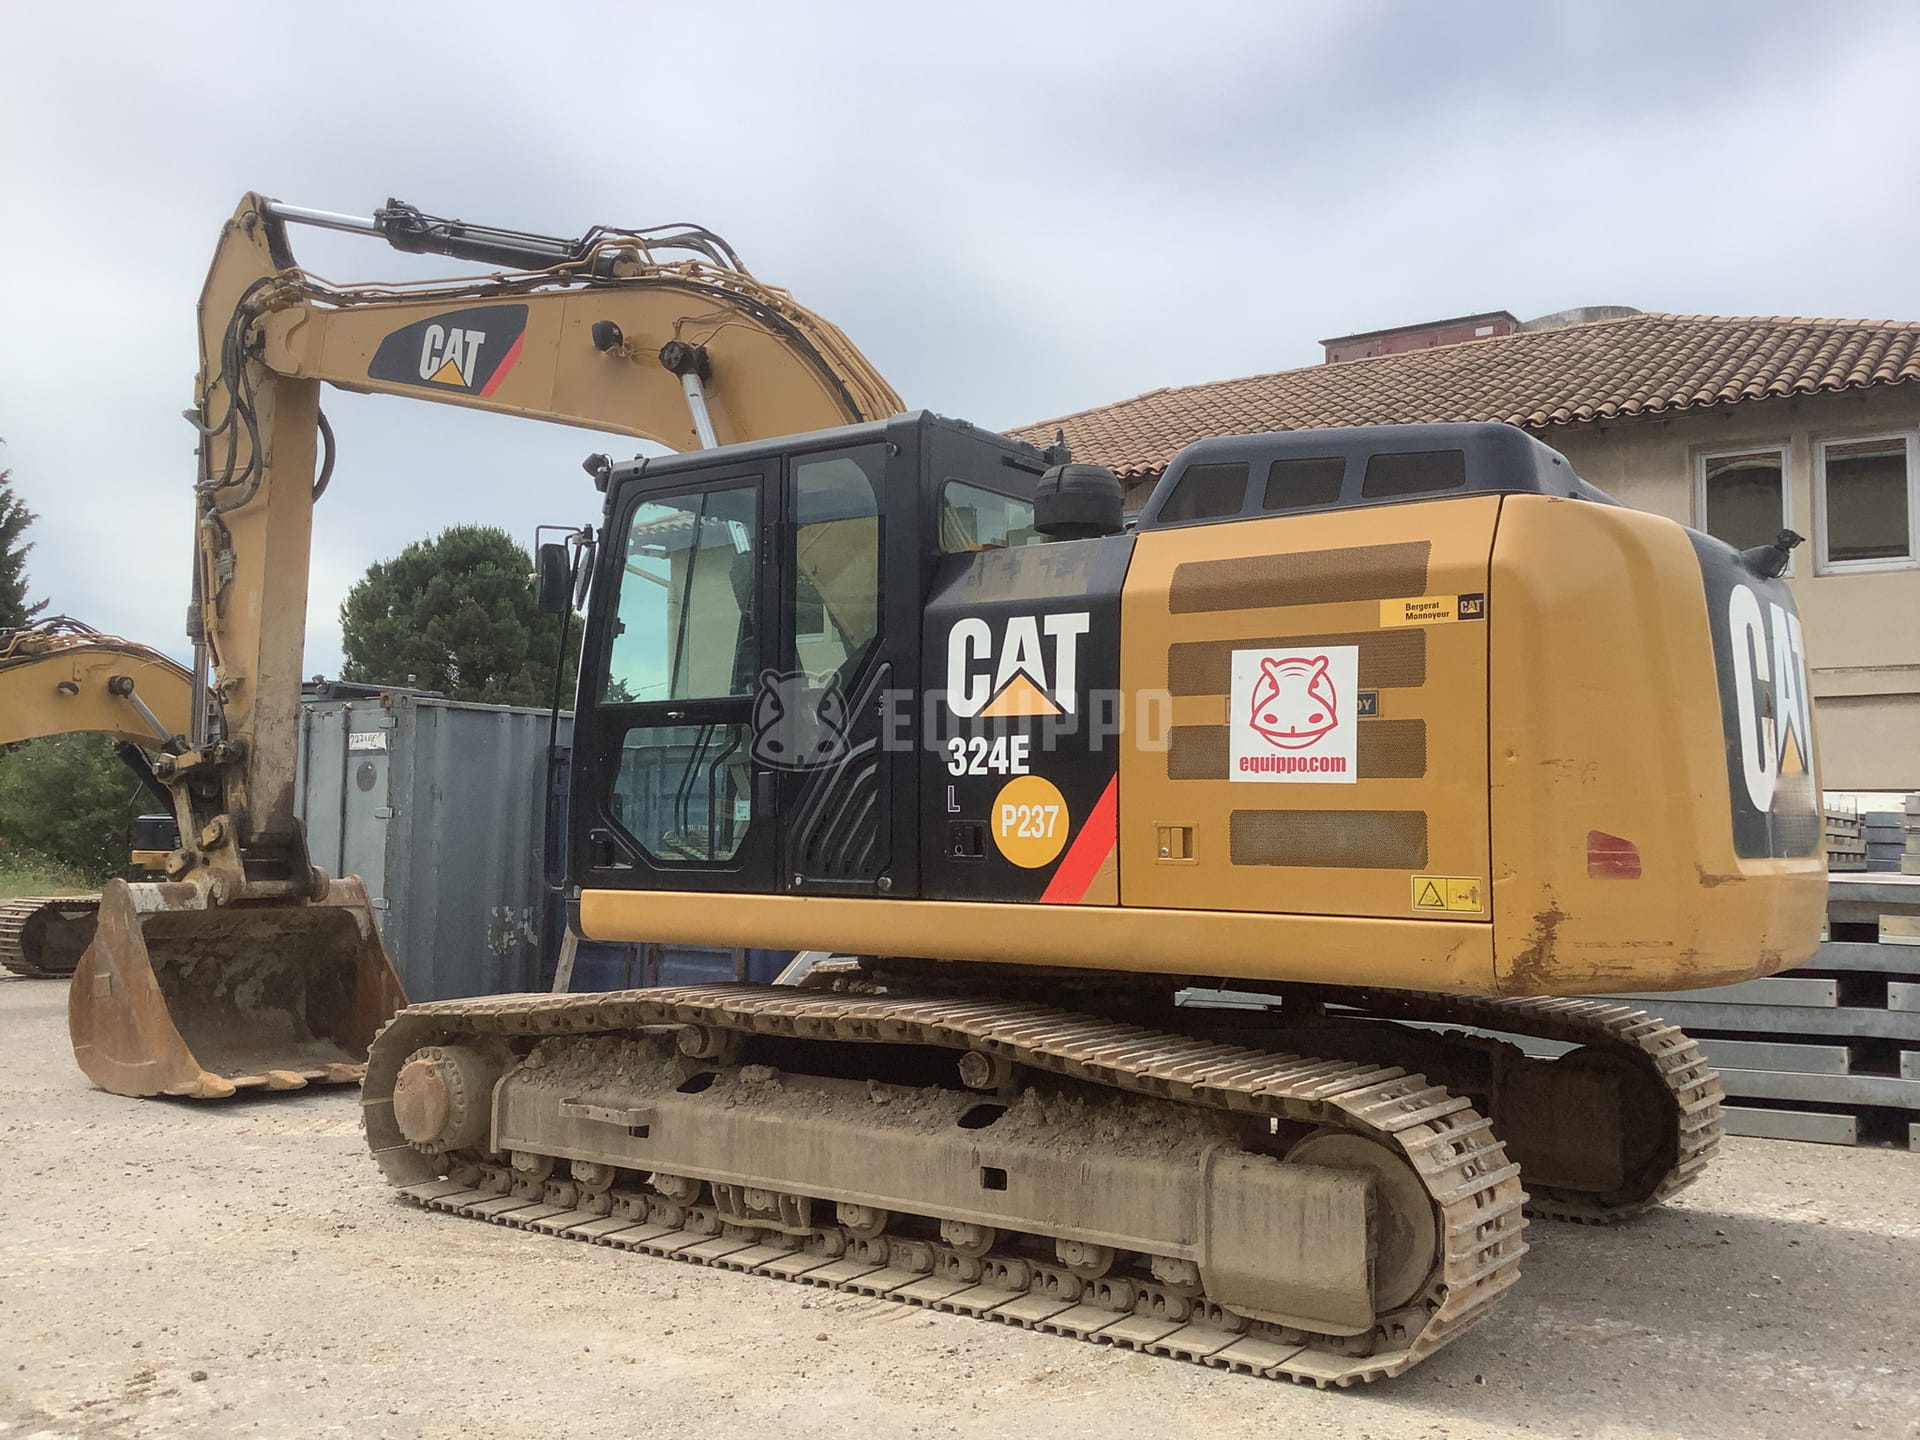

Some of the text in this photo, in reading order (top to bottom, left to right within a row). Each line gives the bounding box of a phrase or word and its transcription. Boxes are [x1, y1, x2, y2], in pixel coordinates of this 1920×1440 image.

[419, 324, 486, 388] CAT
[1405, 602, 1440, 612] Bergerat
[1405, 611, 1450, 621] Monnoyeur
[1460, 600, 1483, 614] CAT
[947, 612, 1090, 718] CAT
[1729, 584, 1818, 816] CAT
[947, 735, 1030, 776] 324E
[1239, 754, 1347, 775] equippo.com
[947, 785, 961, 813] L
[1001, 804, 1060, 839] P237
